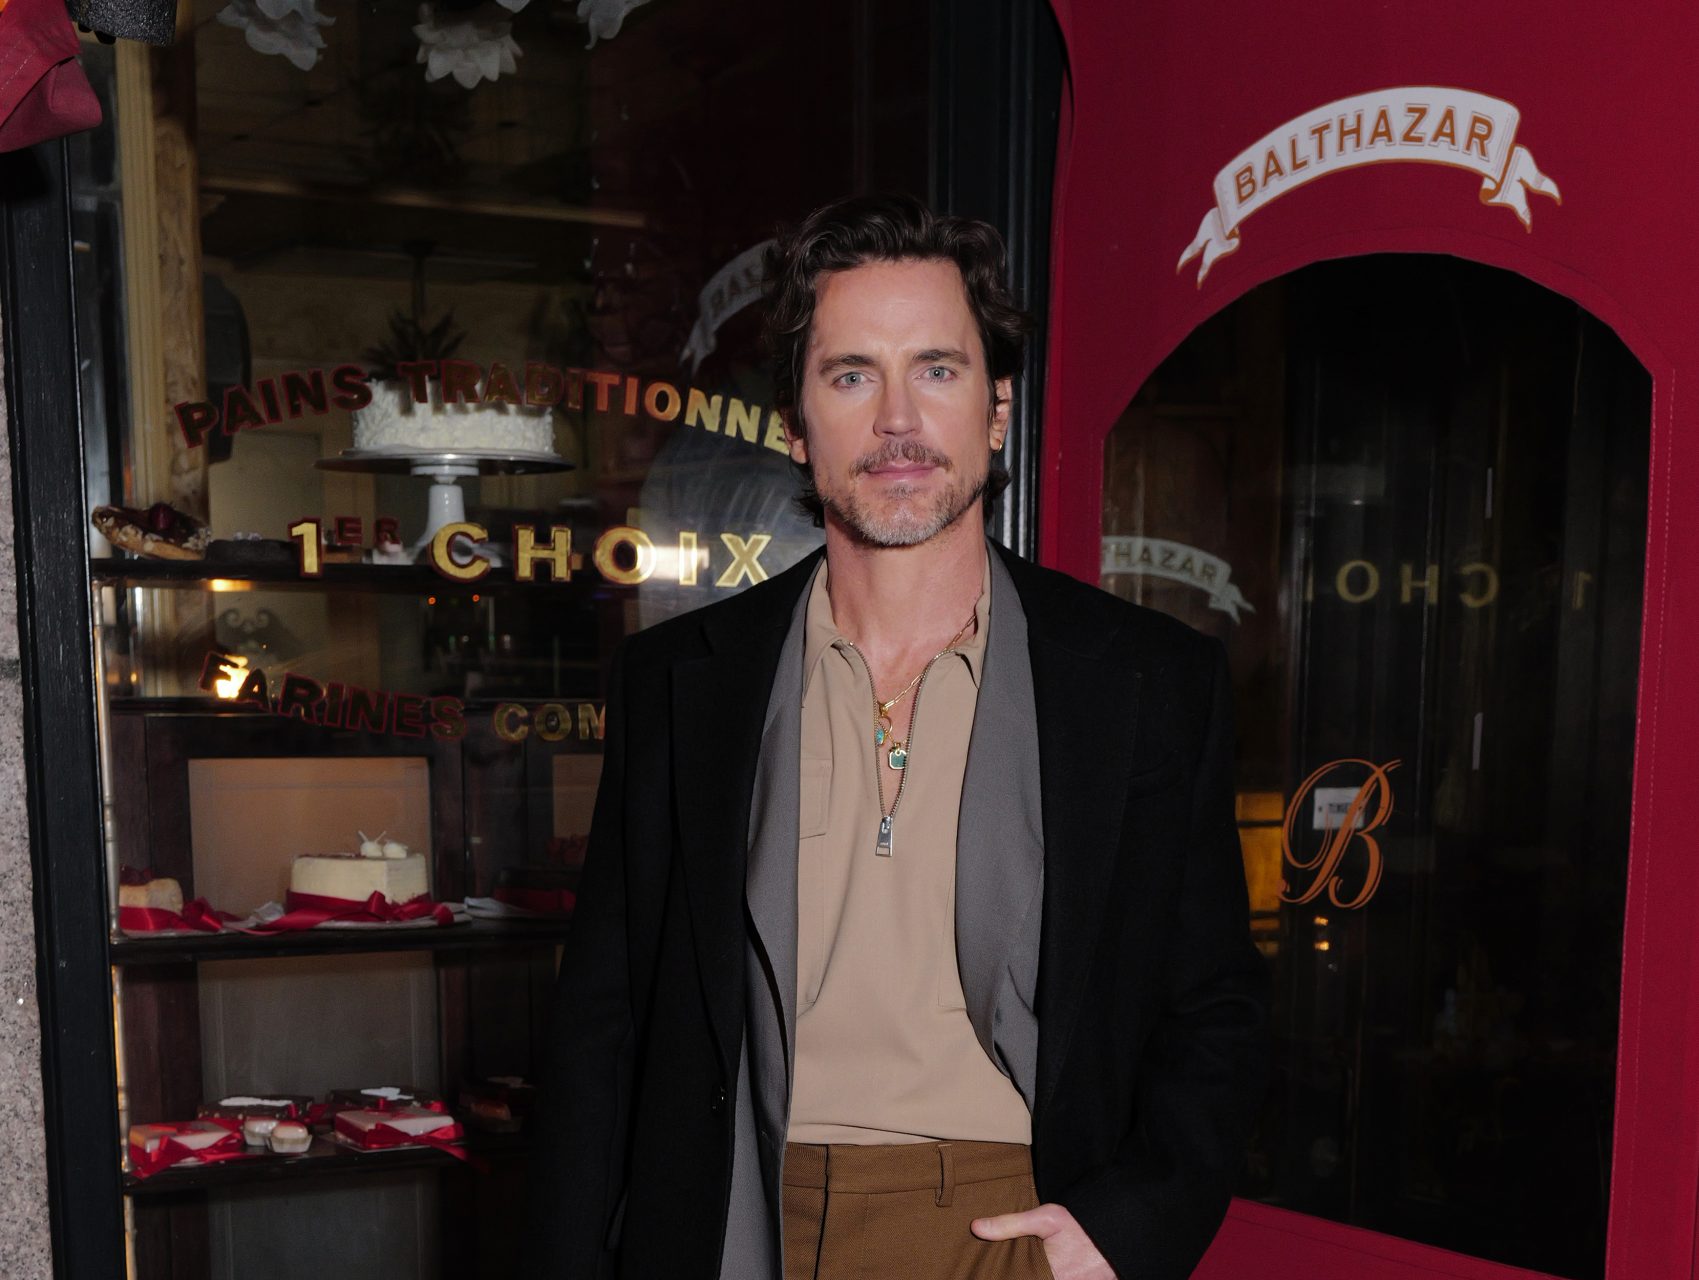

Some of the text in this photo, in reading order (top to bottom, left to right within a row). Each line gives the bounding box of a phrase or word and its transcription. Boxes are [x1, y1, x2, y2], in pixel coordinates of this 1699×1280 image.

[1233, 105, 1494, 205] BALTHAZAR
[174, 365, 374, 449] PAINS
[427, 521, 773, 588] CHOIX
[200, 650, 468, 741] FARINES
[1276, 758, 1402, 910] B
